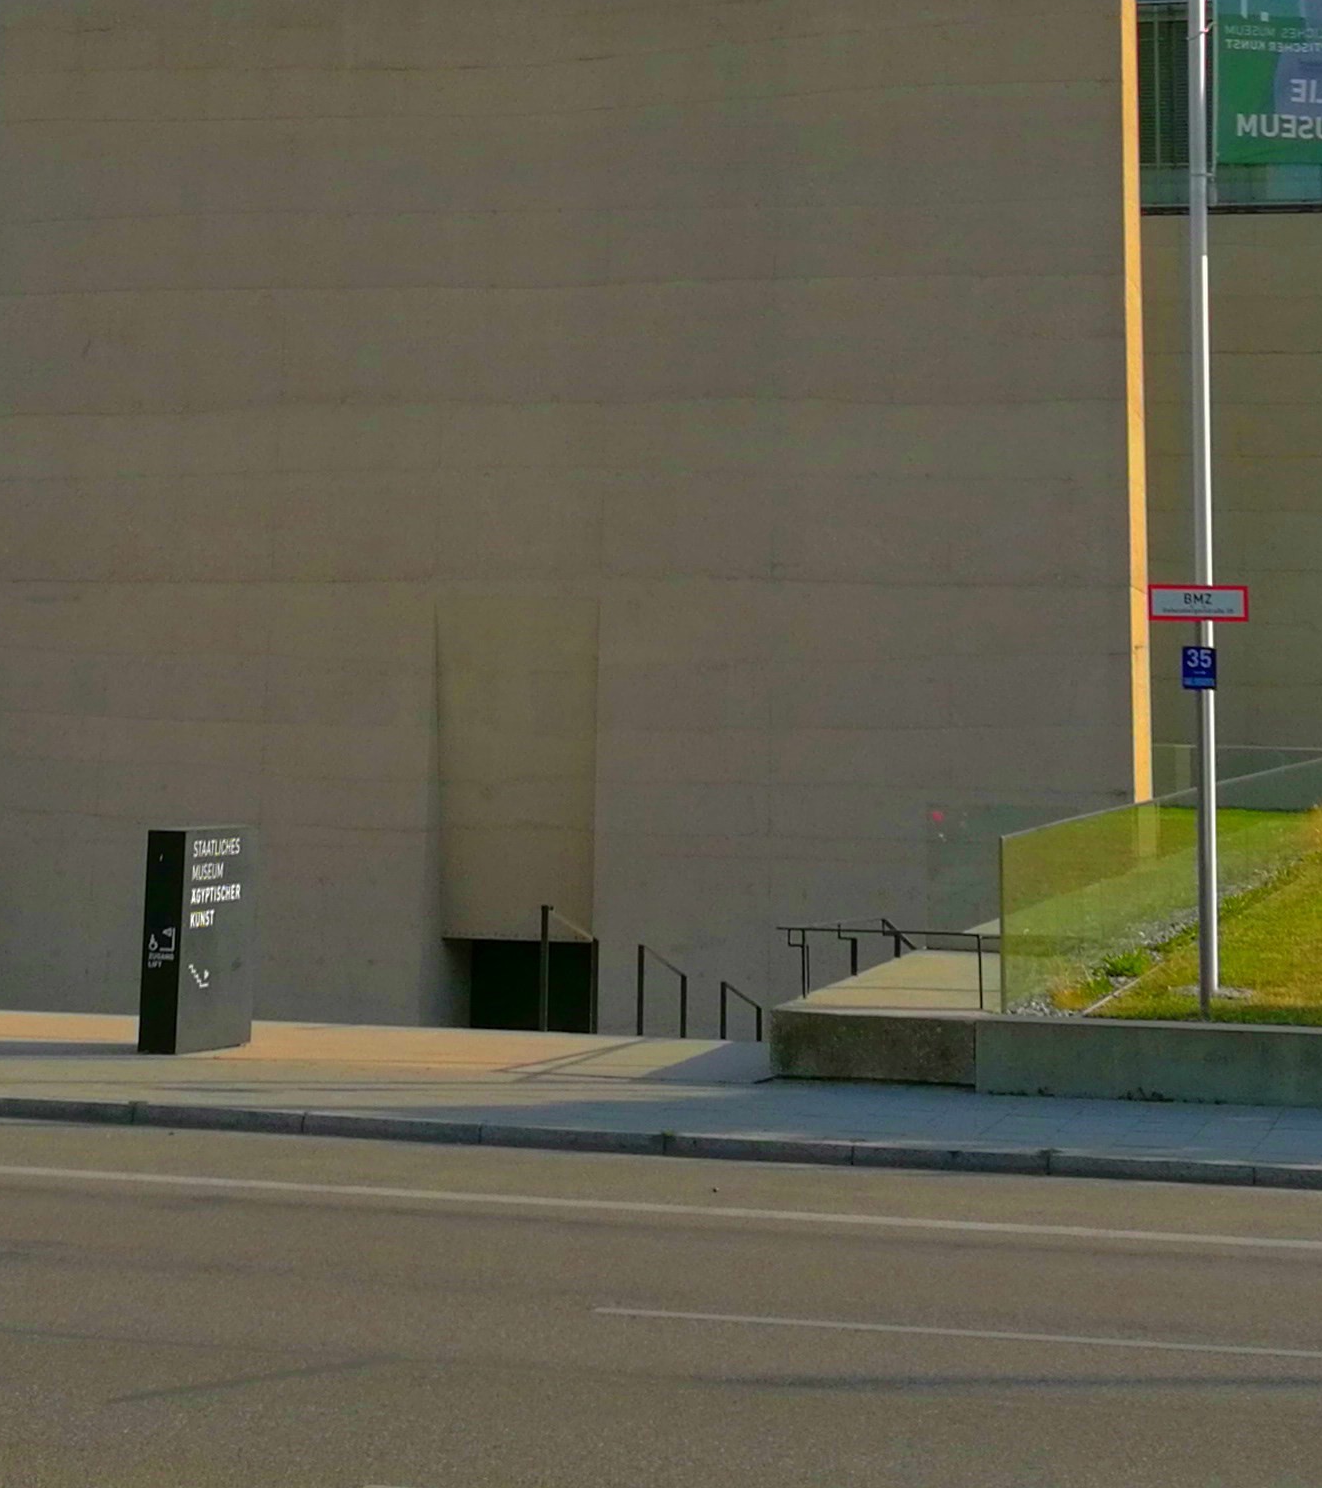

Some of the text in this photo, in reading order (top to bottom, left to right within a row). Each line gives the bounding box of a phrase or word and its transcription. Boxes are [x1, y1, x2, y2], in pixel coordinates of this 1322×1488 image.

[1184, 593, 1212, 605] BMZ
[1186, 649, 1212, 668] 35
[192, 837, 241, 858] STAATLICHES
[191, 862, 225, 883] MUSEUM
[189, 908, 216, 930] KUNST
